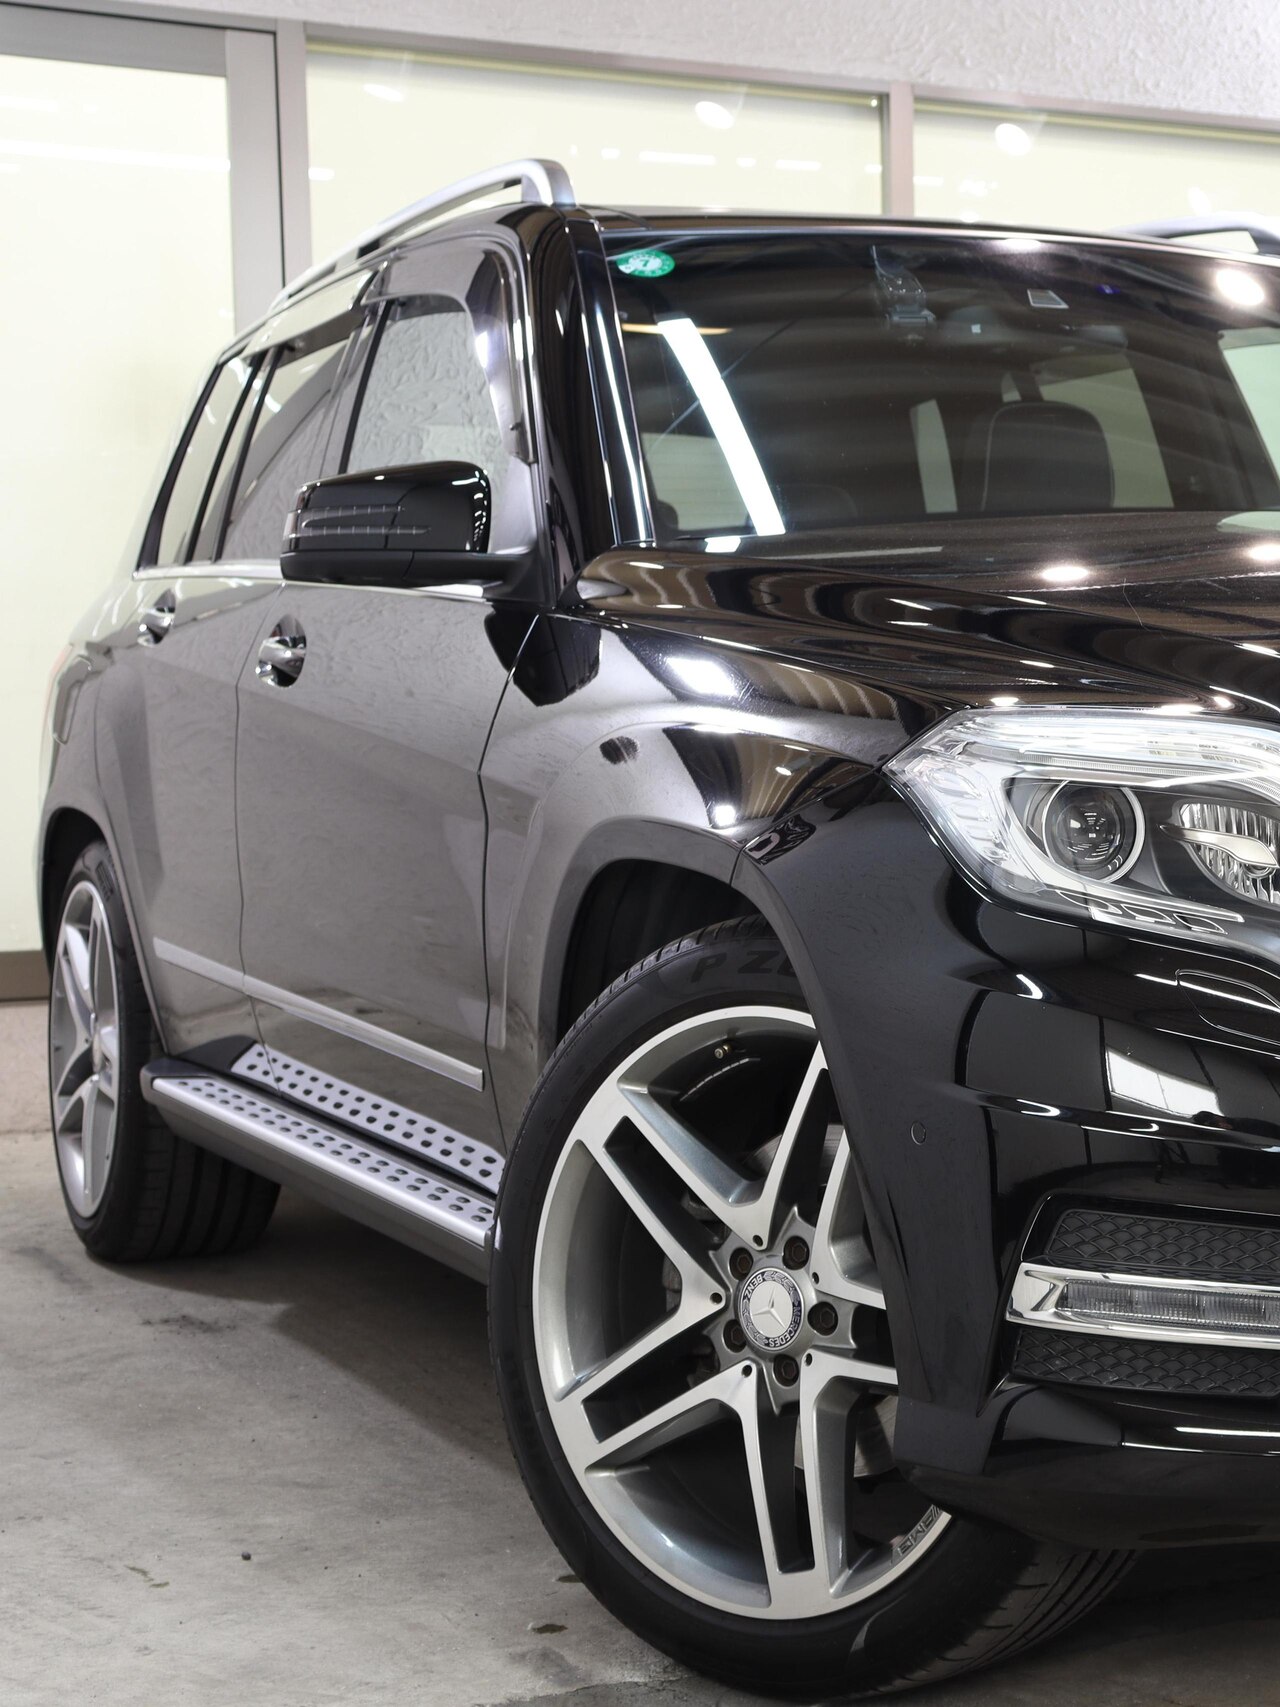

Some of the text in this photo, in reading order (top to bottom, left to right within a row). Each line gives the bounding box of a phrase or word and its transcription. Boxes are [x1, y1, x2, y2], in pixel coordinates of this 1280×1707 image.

[690, 951, 728, 984] P
[744, 1273, 764, 1300] BENZ
[768, 1305, 801, 1348] MERCEDES
